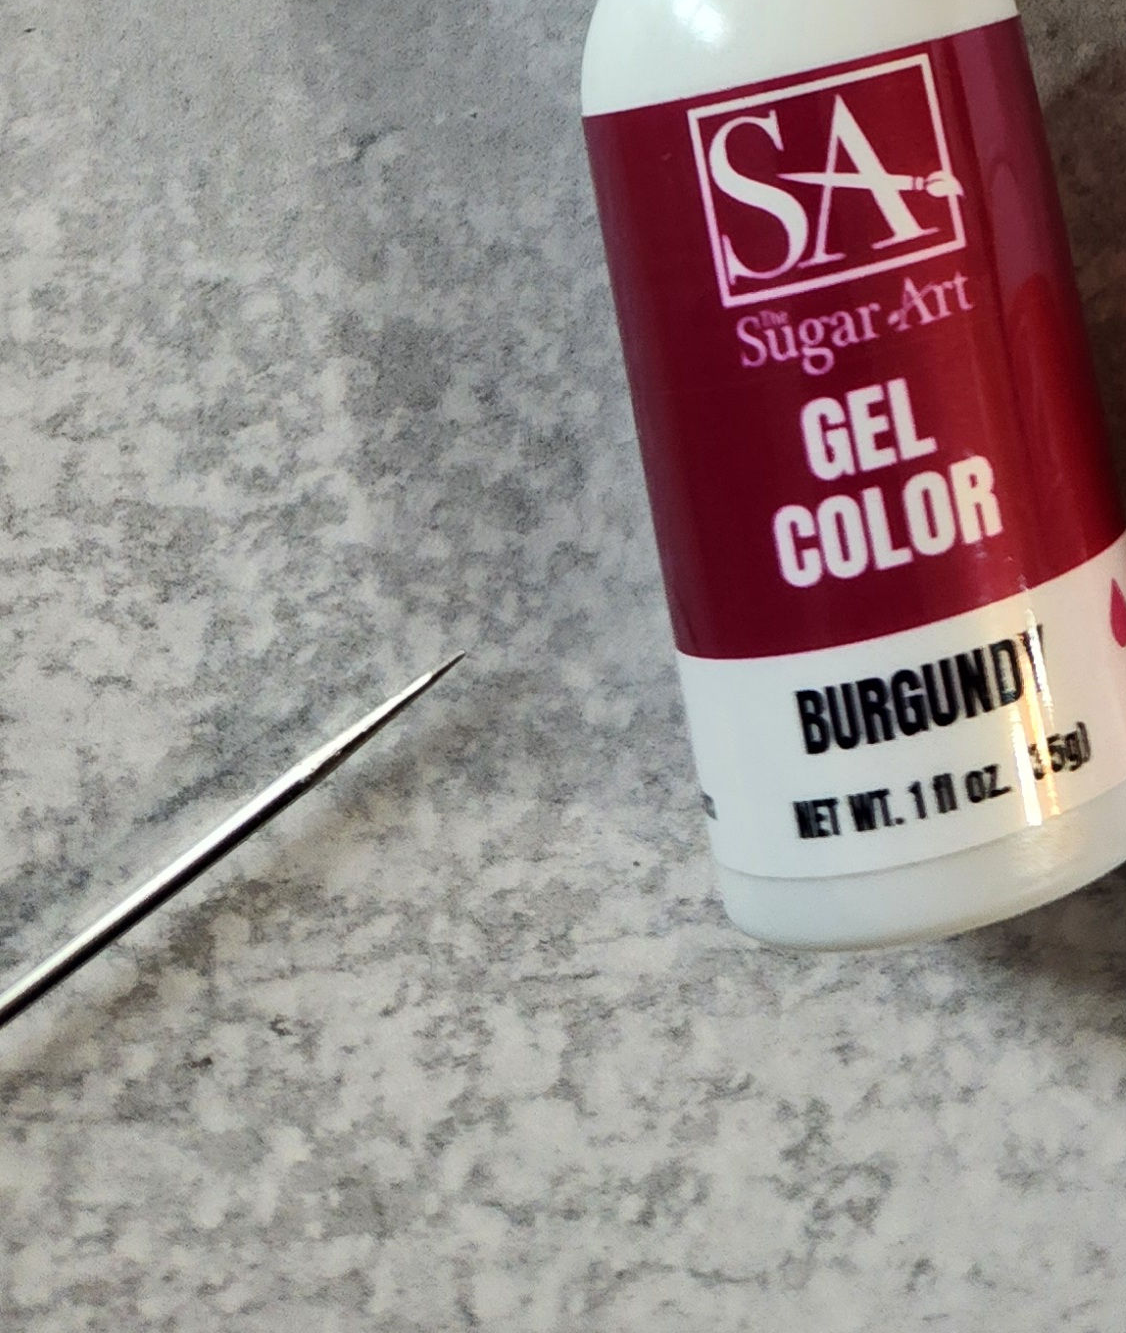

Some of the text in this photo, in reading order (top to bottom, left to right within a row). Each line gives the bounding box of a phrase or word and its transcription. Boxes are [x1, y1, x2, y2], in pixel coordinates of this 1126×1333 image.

[736, 302, 881, 375] Sugar
[801, 378, 937, 480] GEL
[773, 455, 1003, 588] COLOR
[792, 797, 841, 839] NET
[848, 788, 905, 832] WT.
[908, 780, 928, 819] 1
[932, 772, 958, 813] fl
